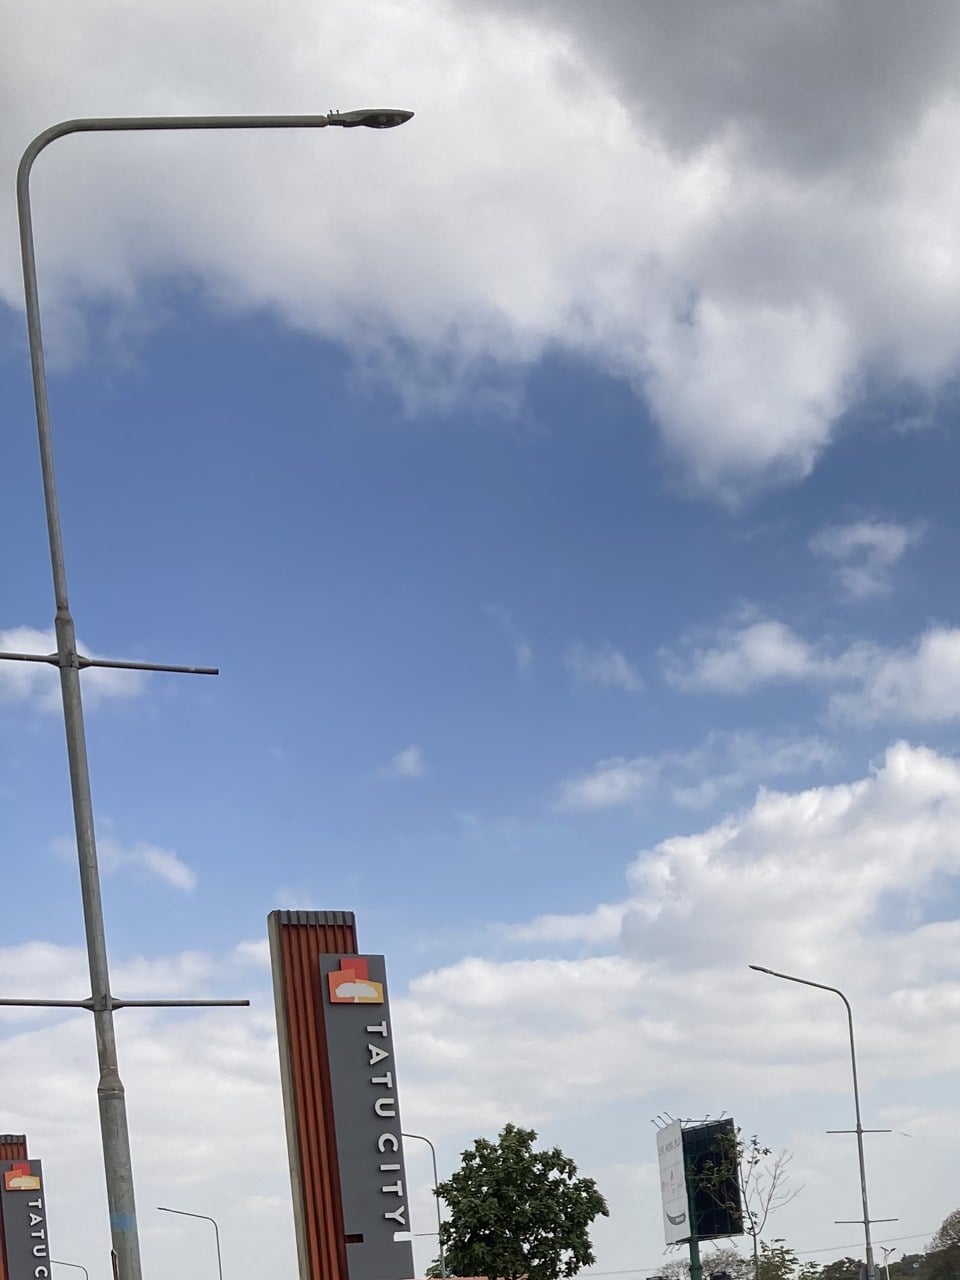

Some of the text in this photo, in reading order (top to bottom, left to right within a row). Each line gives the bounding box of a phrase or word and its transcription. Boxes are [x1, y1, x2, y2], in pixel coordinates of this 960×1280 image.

[366, 1020, 406, 1225] TATU CITY
[28, 1198, 47, 1257] TATU
